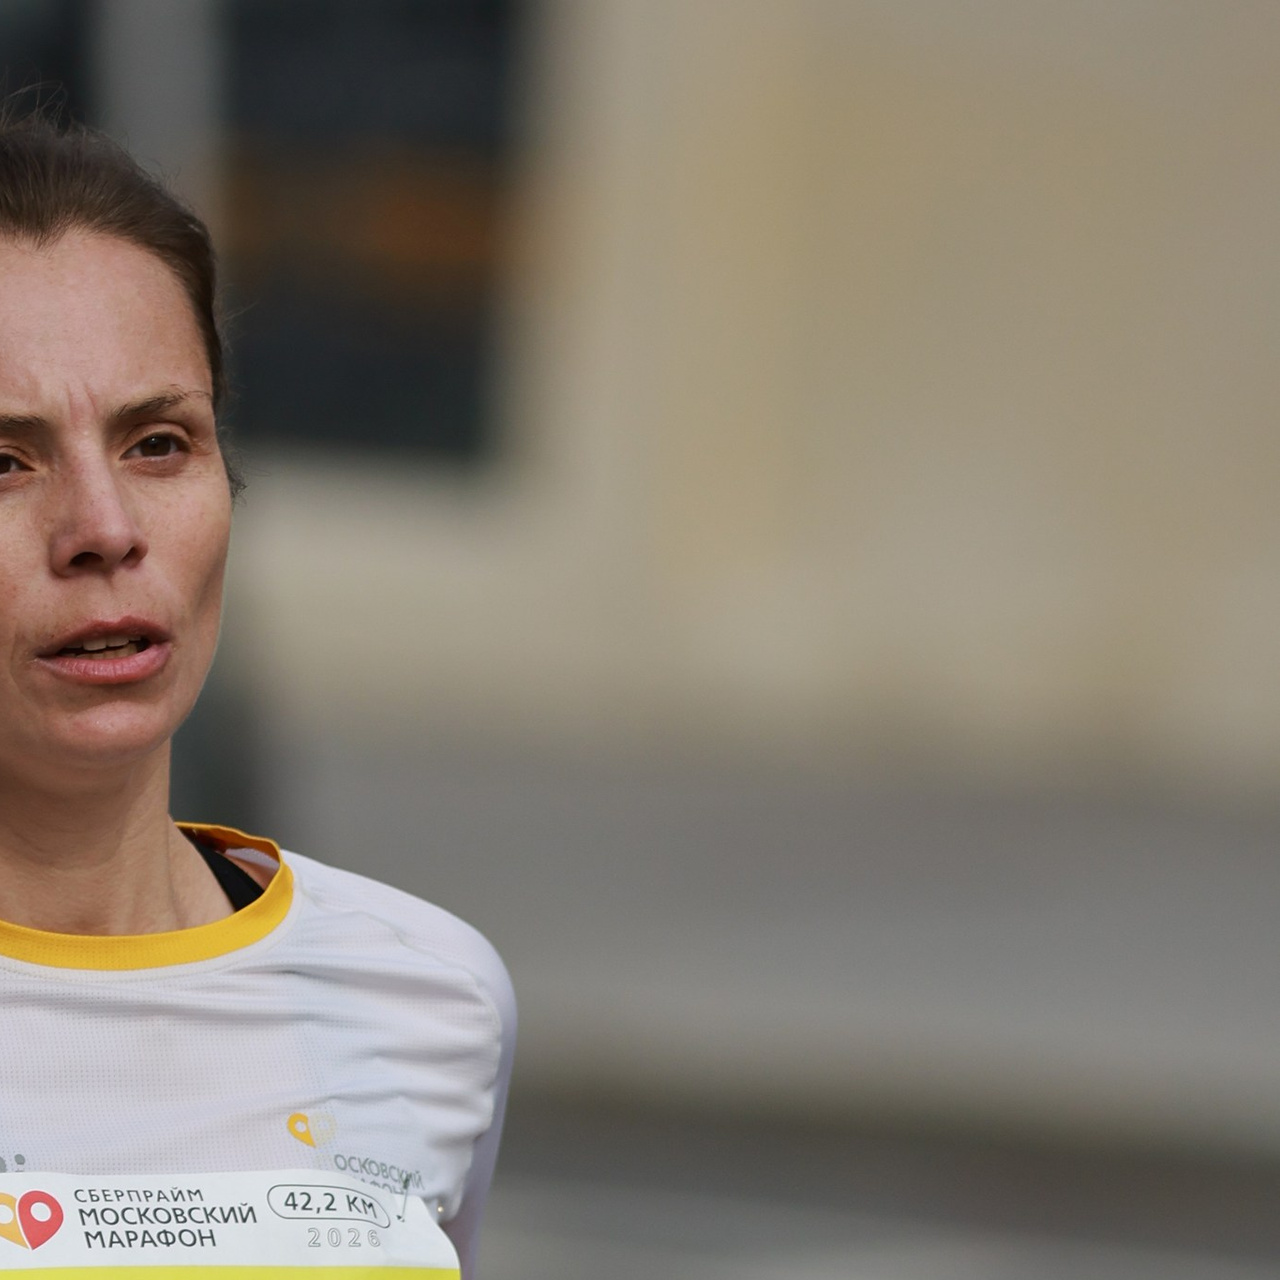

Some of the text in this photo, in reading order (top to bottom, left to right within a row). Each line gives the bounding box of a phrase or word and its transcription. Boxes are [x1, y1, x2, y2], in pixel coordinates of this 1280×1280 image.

[332, 1153, 425, 1191] ОСКОВСКИЙ
[74, 1187, 204, 1203] СБЕРПРАЙМ
[283, 1191, 337, 1214] 42,2
[78, 1202, 258, 1226] МОСКОВСКИЙ
[84, 1229, 217, 1249] МАРАФОН
[307, 1227, 381, 1248] 2026
